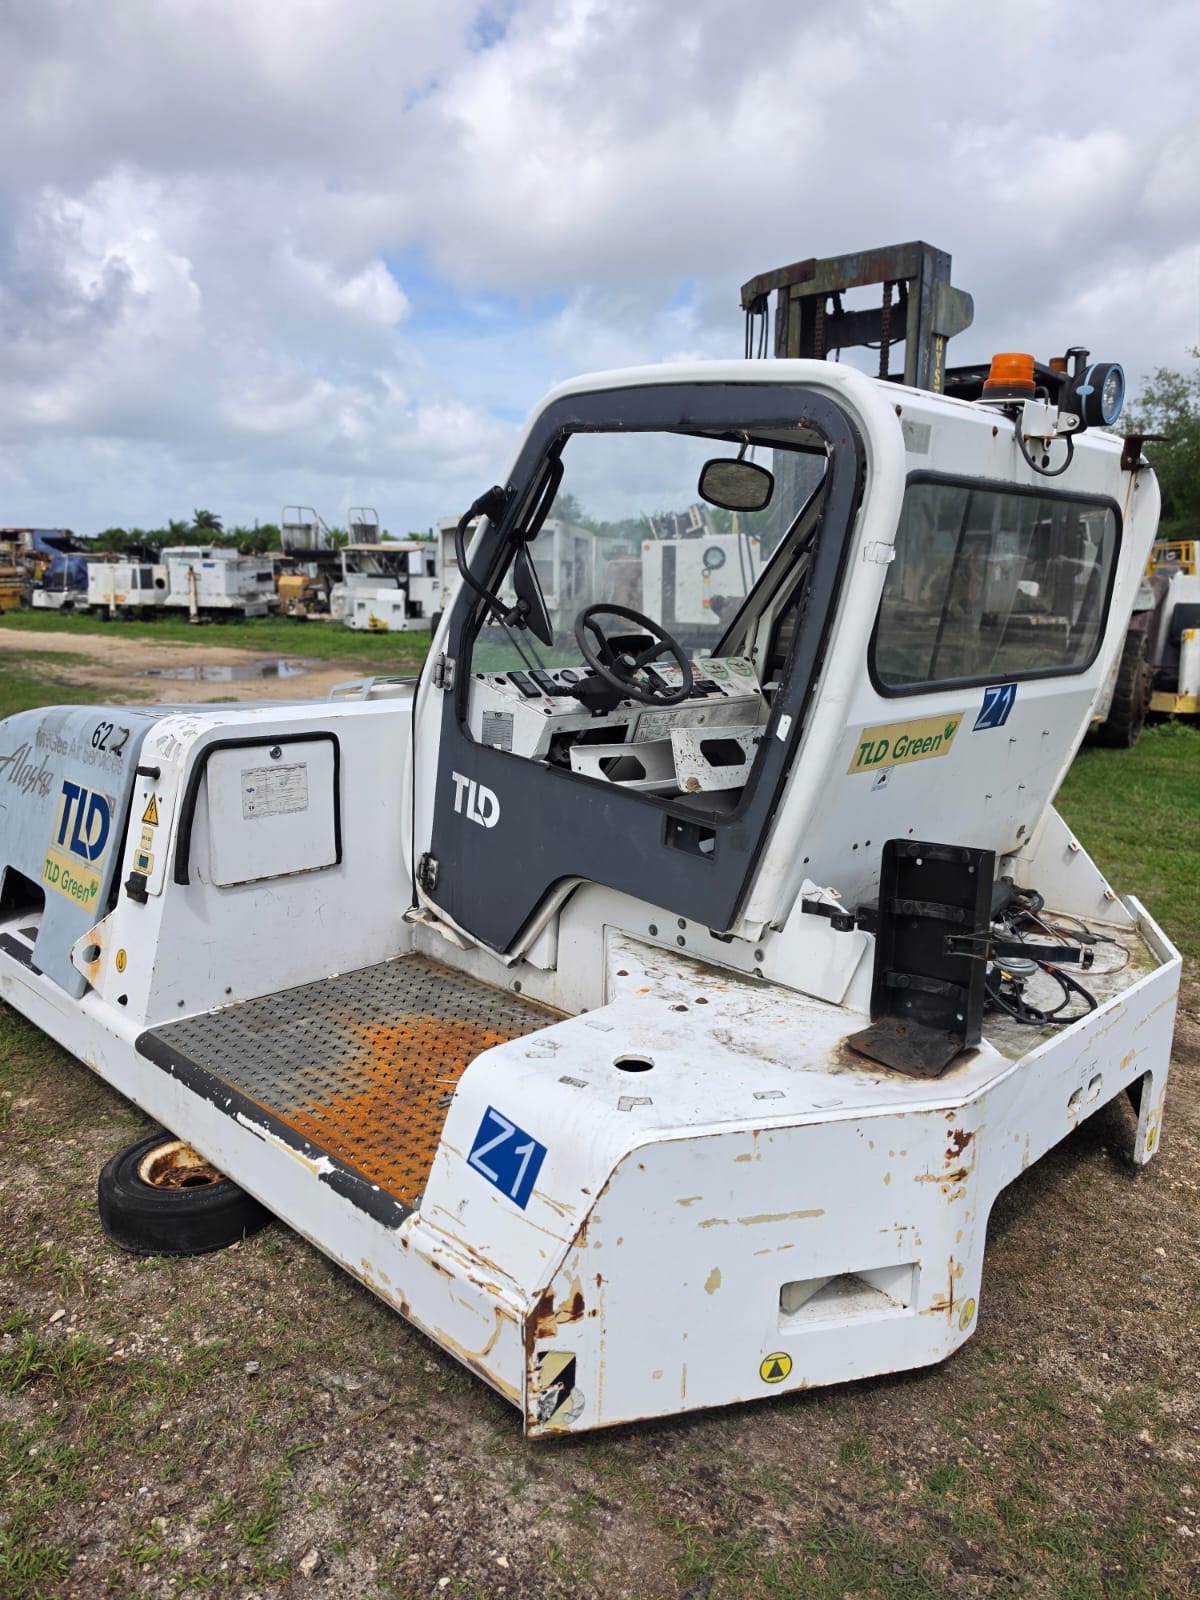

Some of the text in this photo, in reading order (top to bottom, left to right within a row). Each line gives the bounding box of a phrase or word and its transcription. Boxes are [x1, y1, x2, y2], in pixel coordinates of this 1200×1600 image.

[974, 686, 1013, 730] Z1
[857, 735, 943, 767] TLD Green
[58, 780, 110, 861] TLD
[452, 771, 500, 828] TLD
[44, 859, 89, 903] TLD Green
[469, 1110, 536, 1199] Z1
